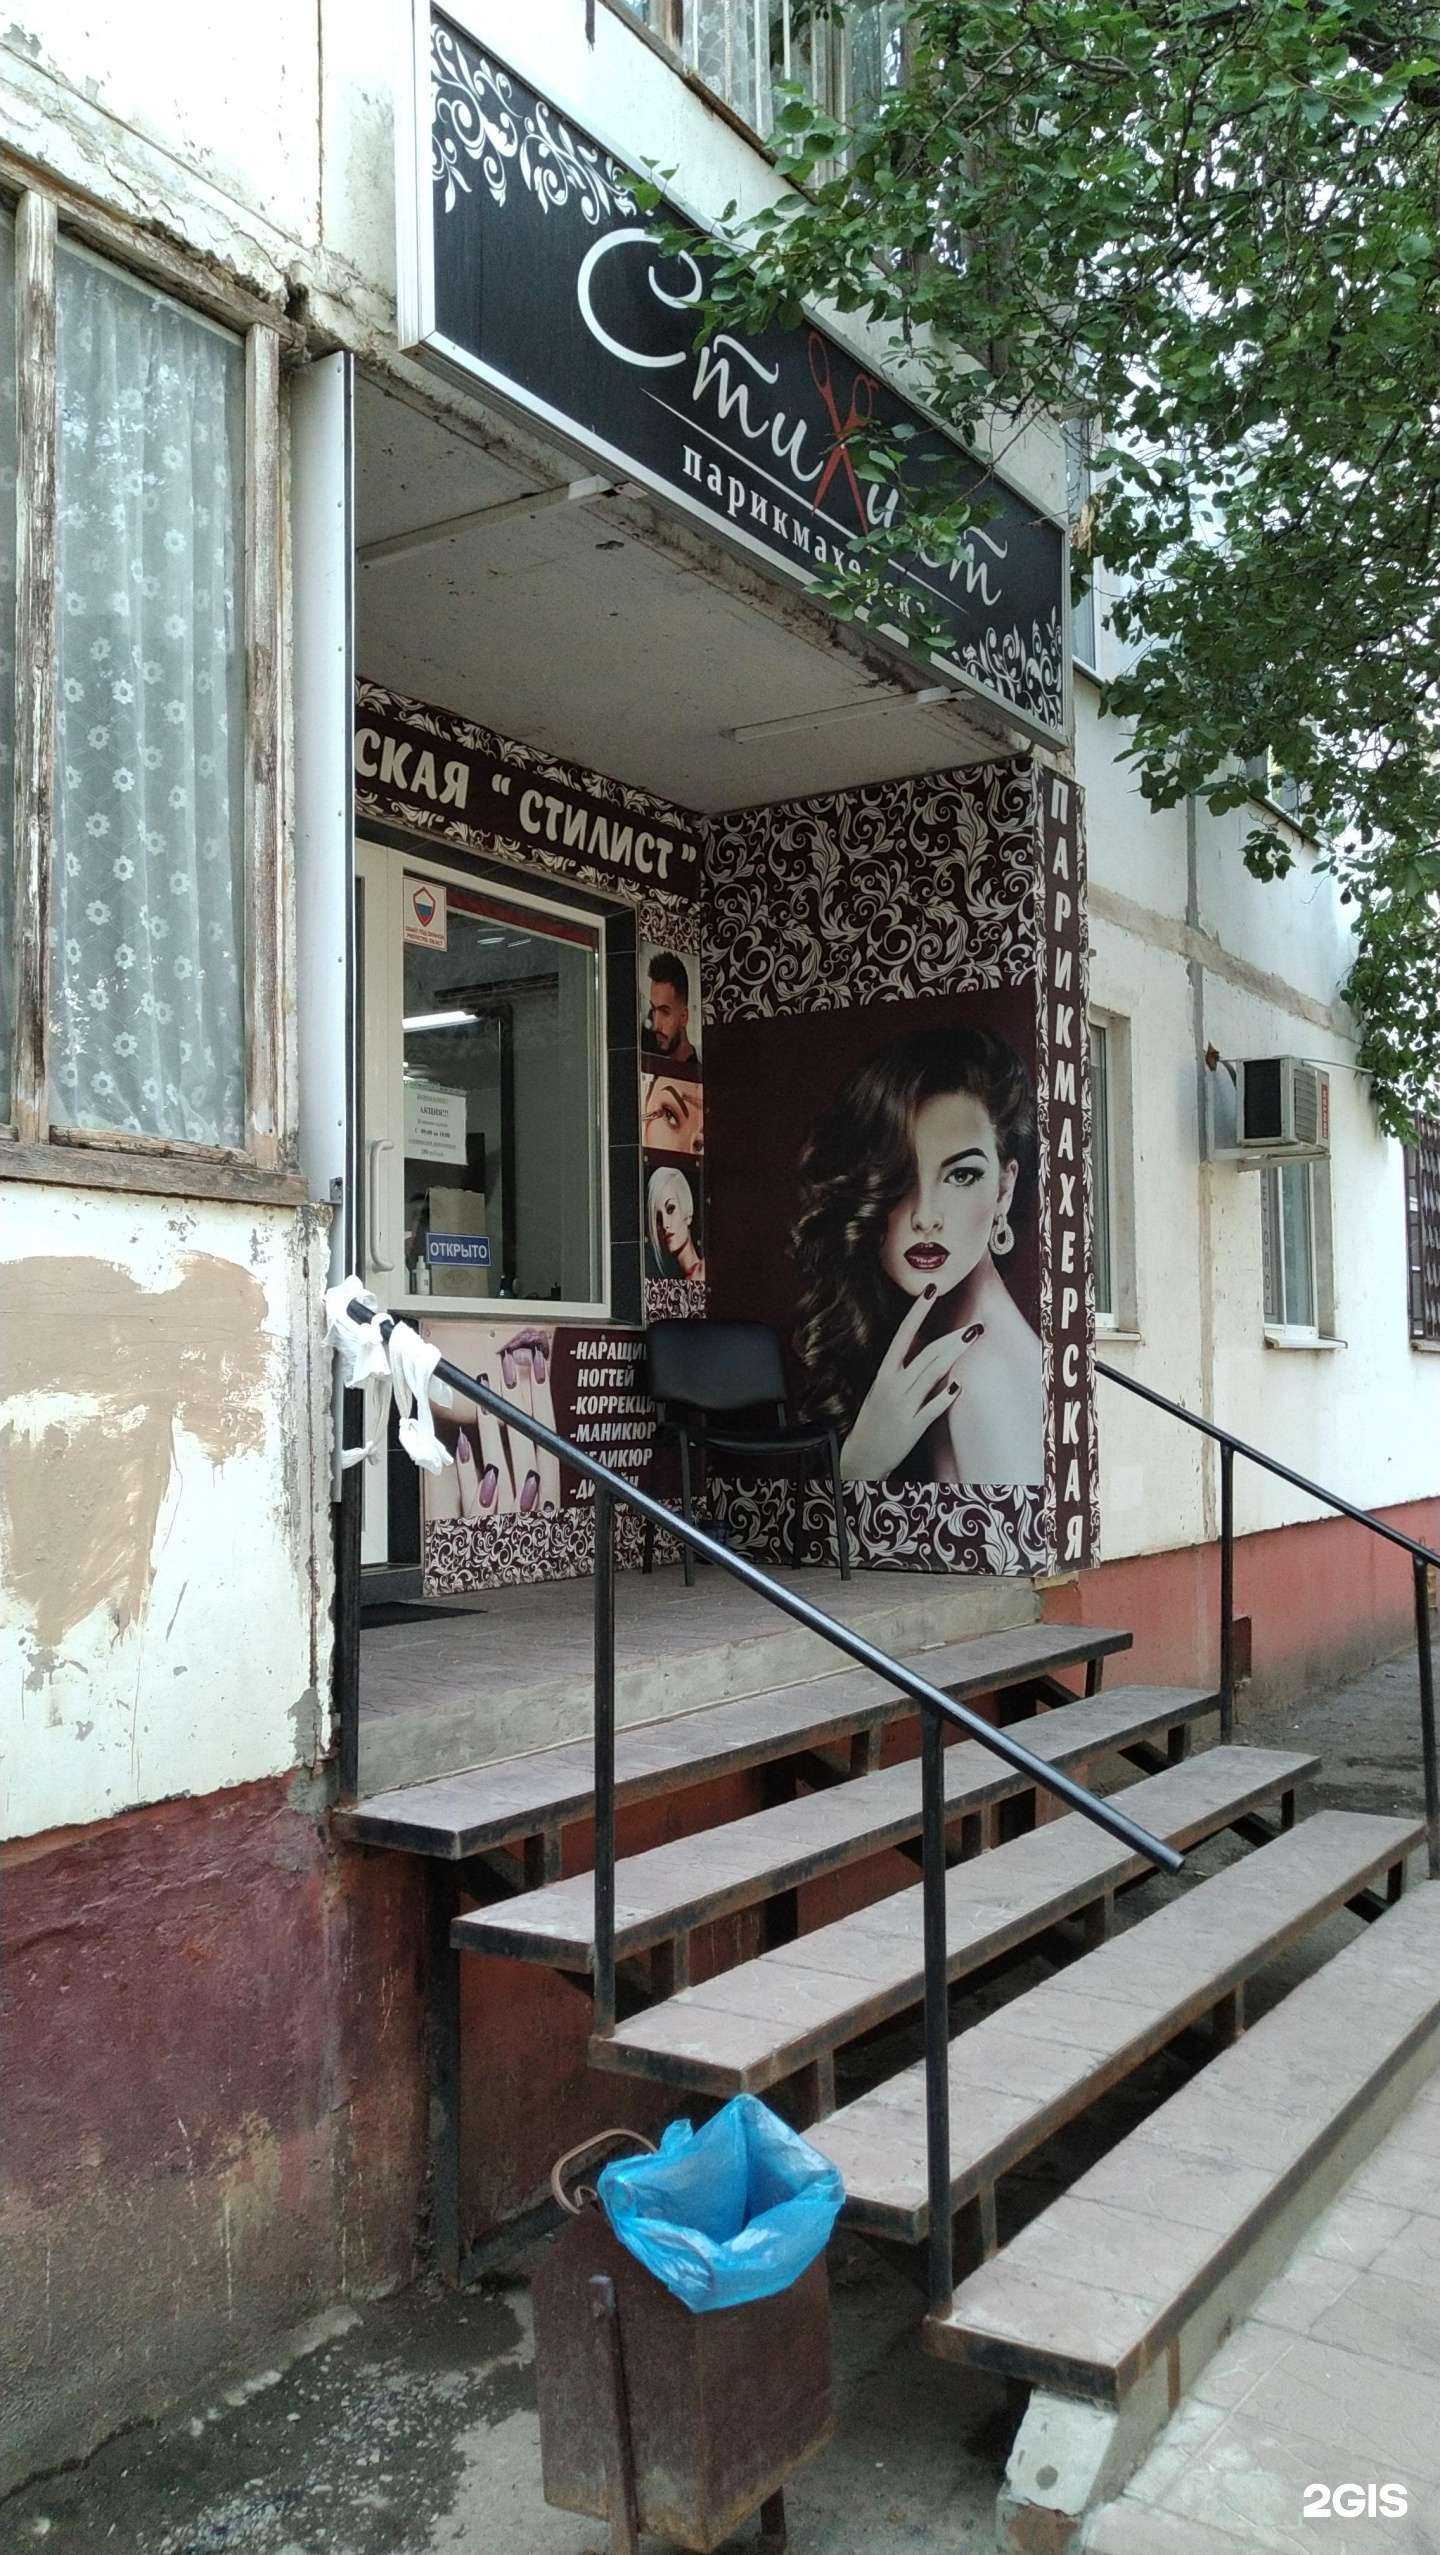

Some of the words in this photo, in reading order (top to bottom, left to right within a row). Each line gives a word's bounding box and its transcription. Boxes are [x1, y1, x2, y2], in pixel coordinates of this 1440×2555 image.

[355, 727, 470, 810] СКАЯ
[1050, 778, 1084, 1562] ПАРИКМАХЕРСКАЯ
[430, 1242, 487, 1258] ОТКРЫТО
[577, 1364, 635, 1387] НОГТЕЙ
